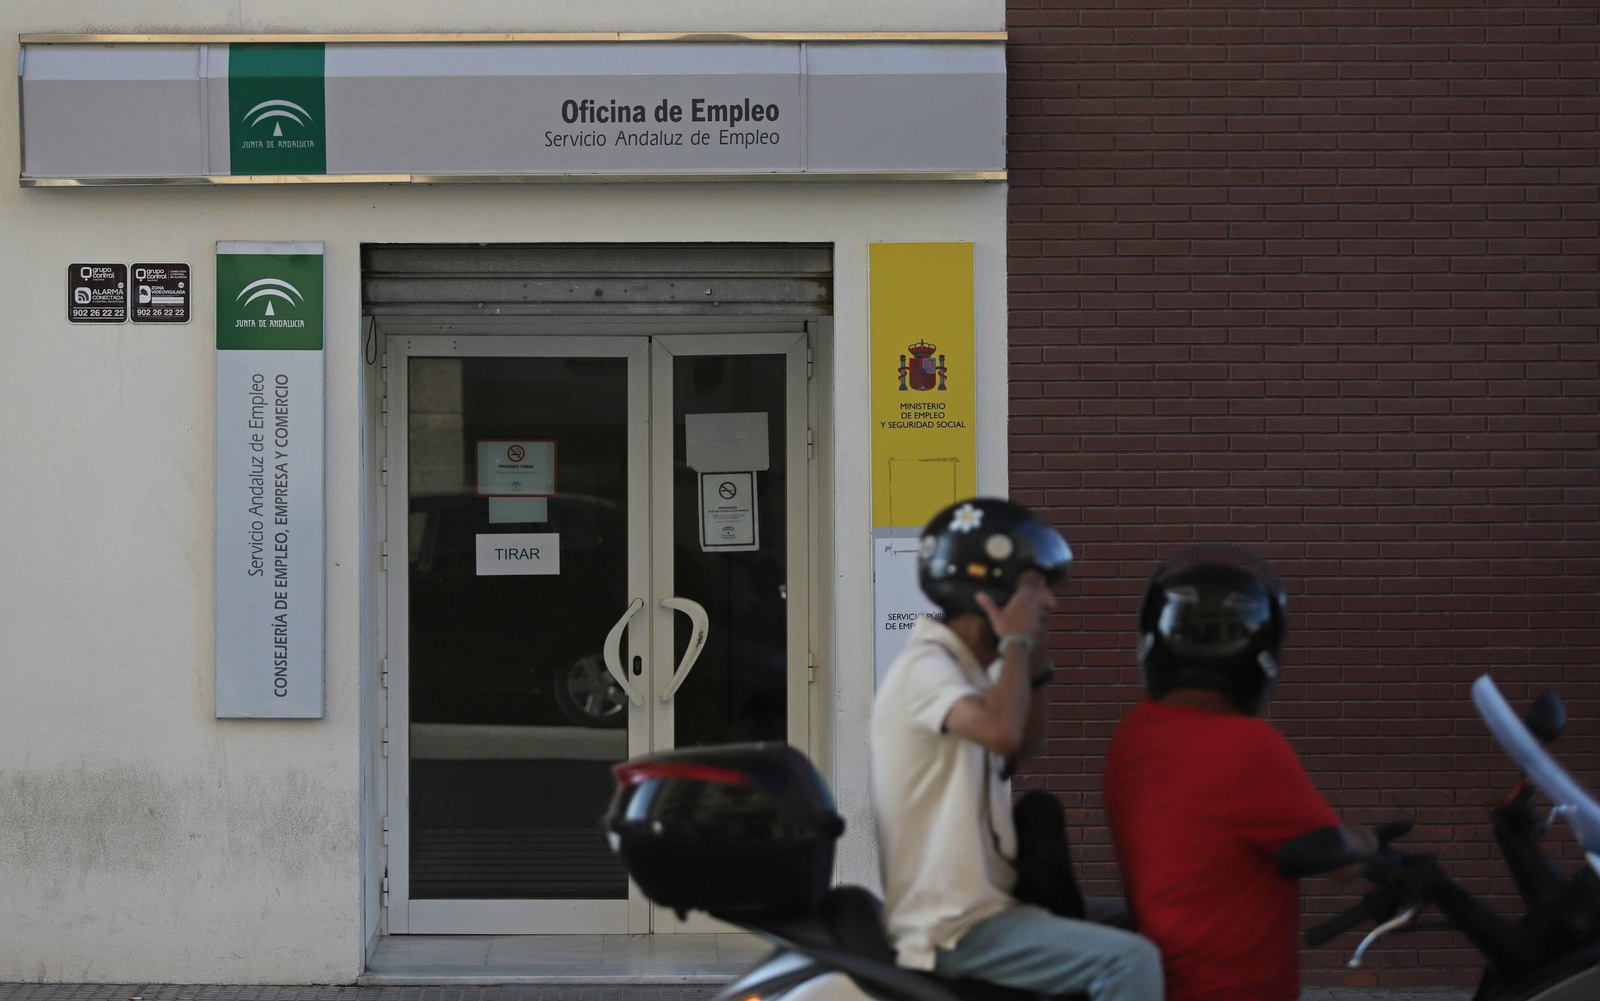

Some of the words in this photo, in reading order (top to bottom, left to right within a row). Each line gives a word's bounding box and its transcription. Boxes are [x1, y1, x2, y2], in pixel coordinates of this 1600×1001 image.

[562, 98, 645, 124] Oficina
[655, 98, 682, 123] de
[692, 97, 780, 127] Empleo
[242, 140, 263, 149] JUNTA
[266, 140, 275, 149] DE
[544, 130, 607, 148] Servicio
[615, 129, 683, 147] Andaluz
[691, 129, 711, 146] de
[719, 128, 780, 149] Empleo
[73, 309, 88, 317] 902
[90, 309, 101, 317] 26
[102, 309, 113, 317] 22
[114, 309, 125, 317] 22
[137, 308, 151, 316] 902
[152, 308, 162, 316] 26
[163, 308, 174, 316] 22
[175, 308, 185, 316] 22
[234, 319, 256, 328] JUNTA
[258, 319, 267, 328] DE
[249, 373, 269, 429] Empleo
[900, 402, 946, 410] MINISTERIO
[274, 374, 289, 448] COMERCIO
[900, 411, 911, 420] DE
[913, 411, 946, 420] EMPLEO
[880, 421, 887, 429] Y
[887, 421, 935, 429] SEGURIDAD
[936, 420, 965, 429] SOCIAL
[249, 433, 264, 452] de
[274, 450, 288, 460] Y
[249, 457, 264, 516] Andaluz
[274, 462, 288, 525] EMPRESA
[248, 521, 263, 577] Servicio
[494, 547, 541, 562] TIRAR
[274, 529, 290, 588] EMPLEO,
[274, 592, 288, 610] DE
[885, 622, 897, 631] DE
[898, 622, 915, 631] EMP
[270, 614, 288, 698] CONSEJERÍA
